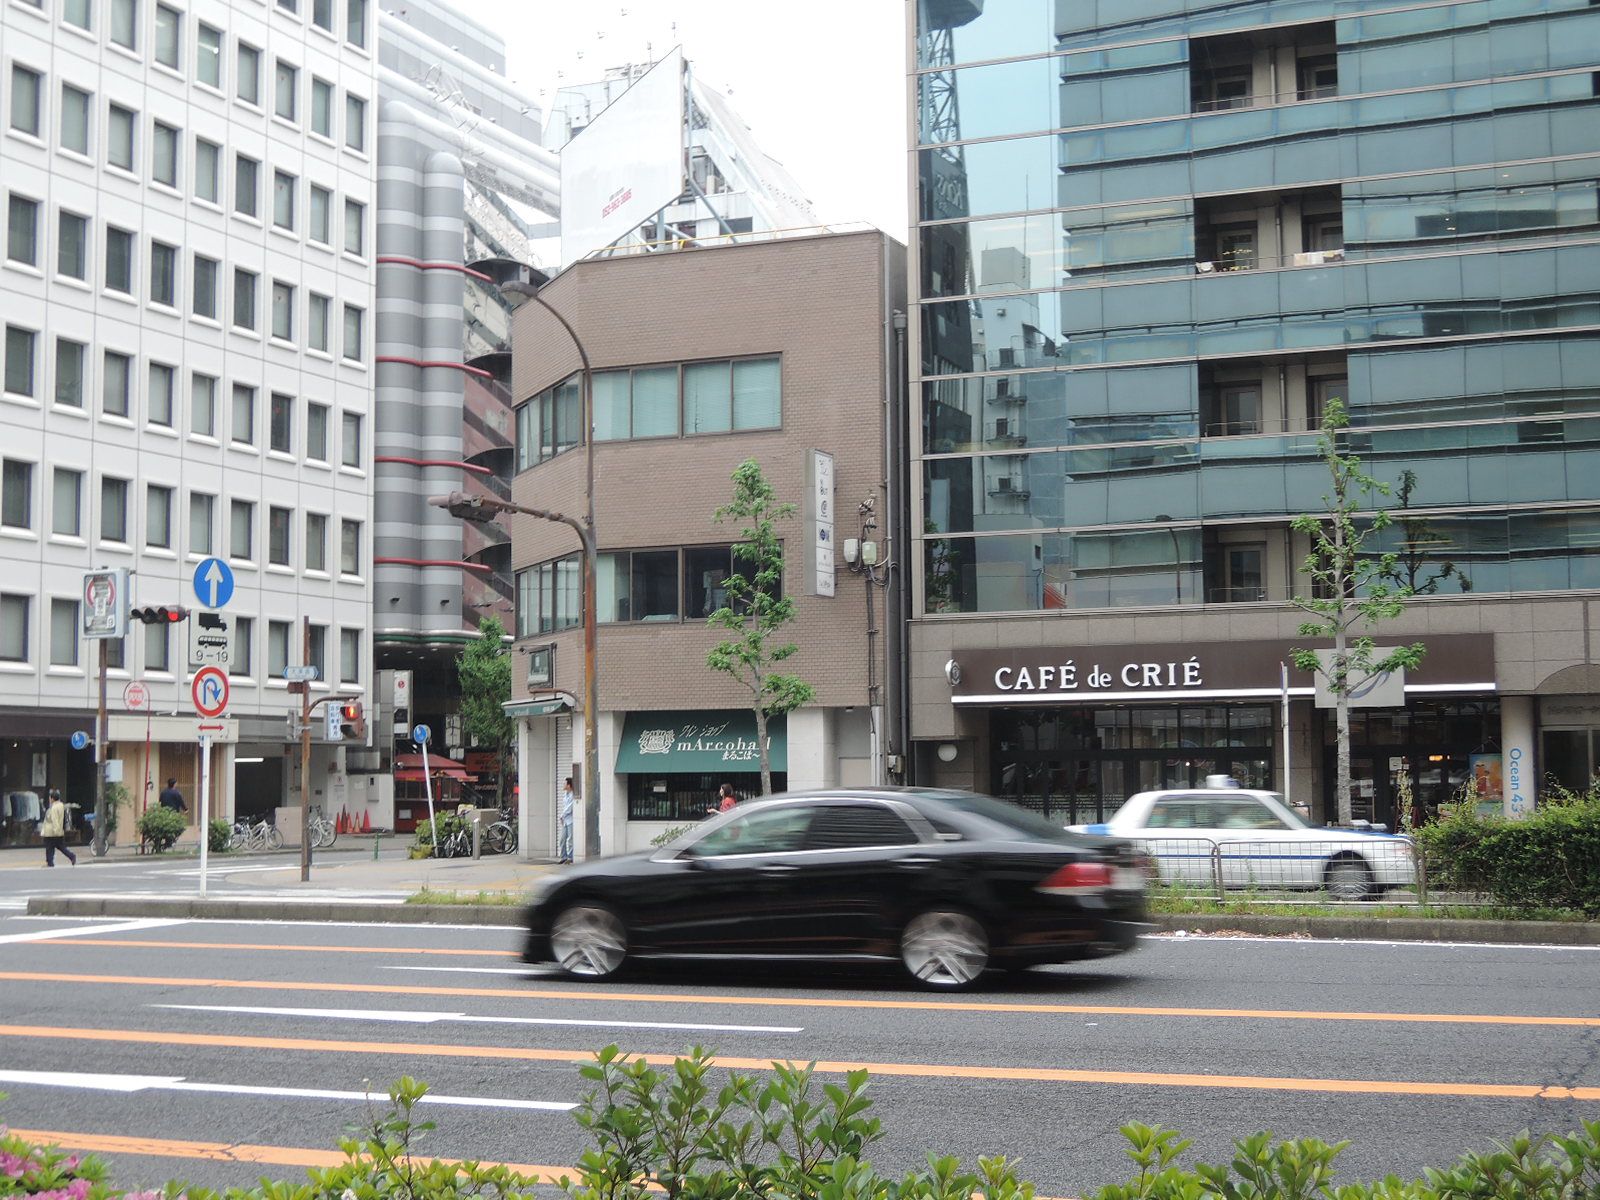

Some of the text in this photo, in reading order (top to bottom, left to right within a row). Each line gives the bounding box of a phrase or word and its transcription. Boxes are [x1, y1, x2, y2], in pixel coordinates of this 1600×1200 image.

[994, 656, 1204, 691] CAFÉ de CRIÉ
[700, 721, 730, 737] ショップ
[678, 736, 771, 750] mArcohal
[1510, 748, 1522, 790] Ocean
